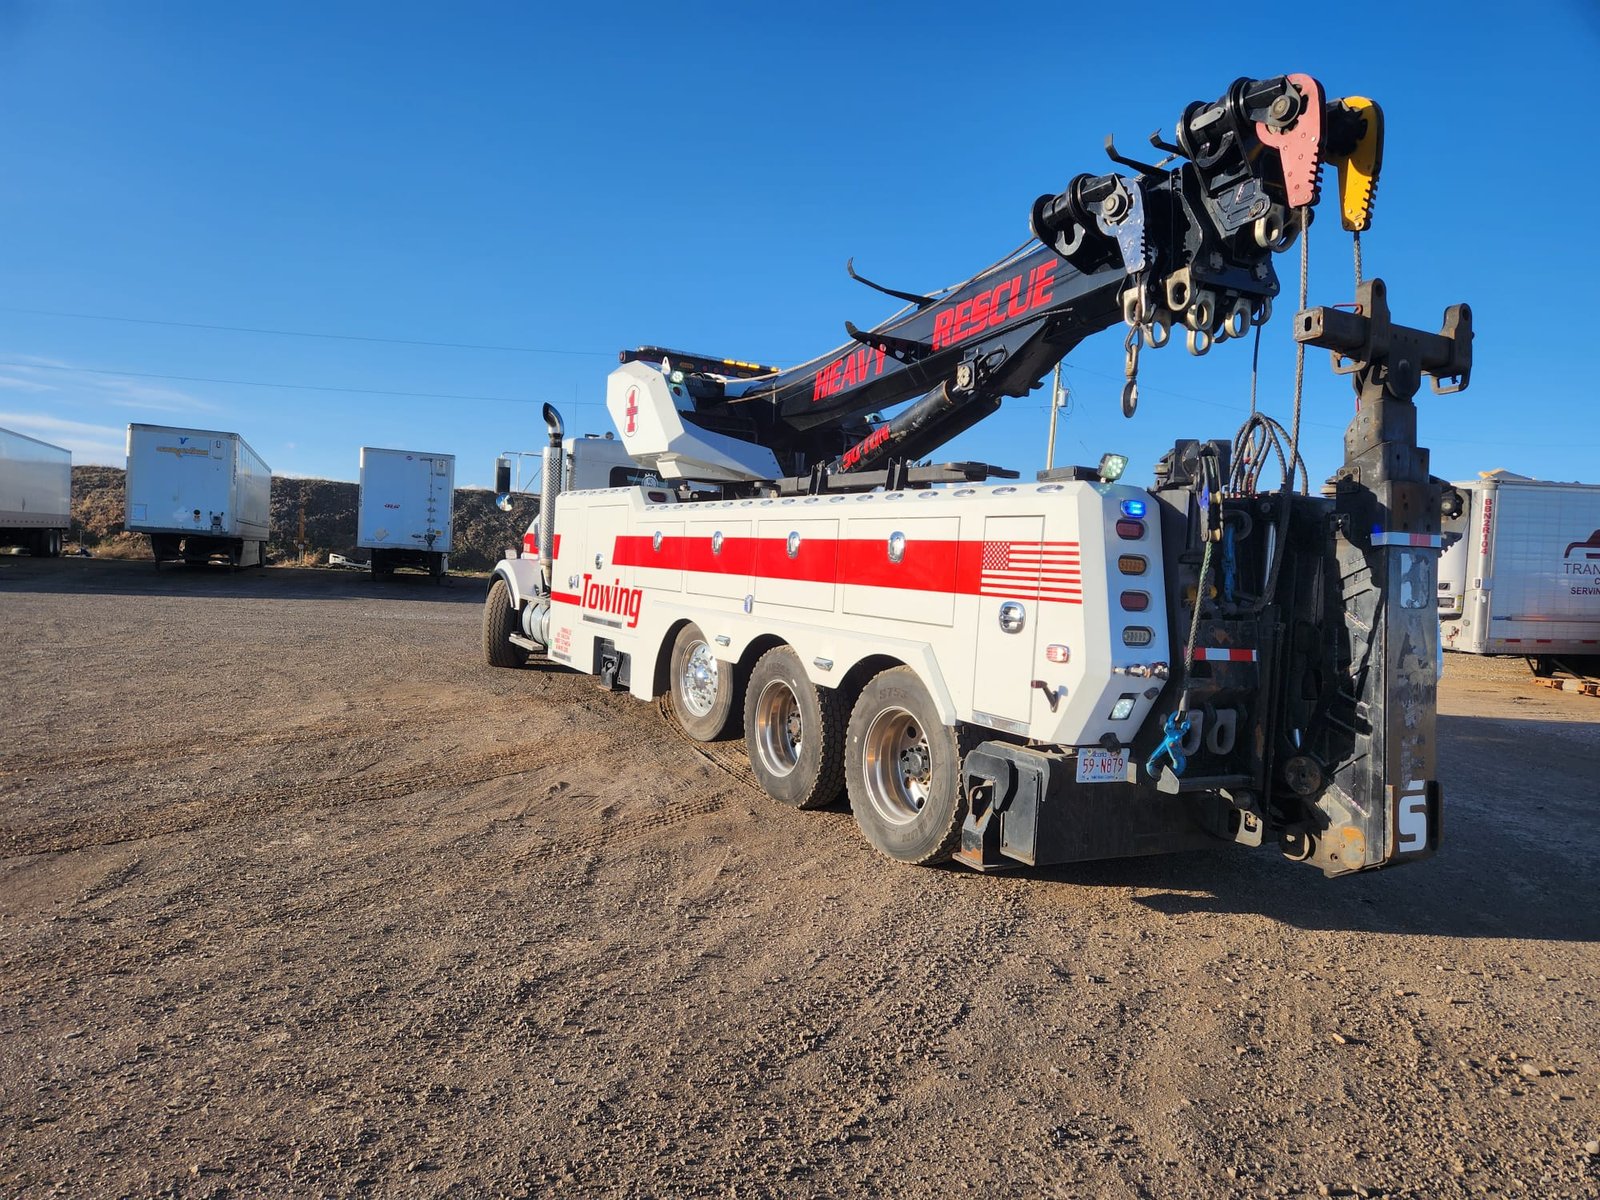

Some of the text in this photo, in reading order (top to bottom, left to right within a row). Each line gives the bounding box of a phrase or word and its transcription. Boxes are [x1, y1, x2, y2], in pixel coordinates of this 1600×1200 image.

[813, 258, 1058, 402] HEAVY RESCUE
[582, 573, 642, 628] Towing
